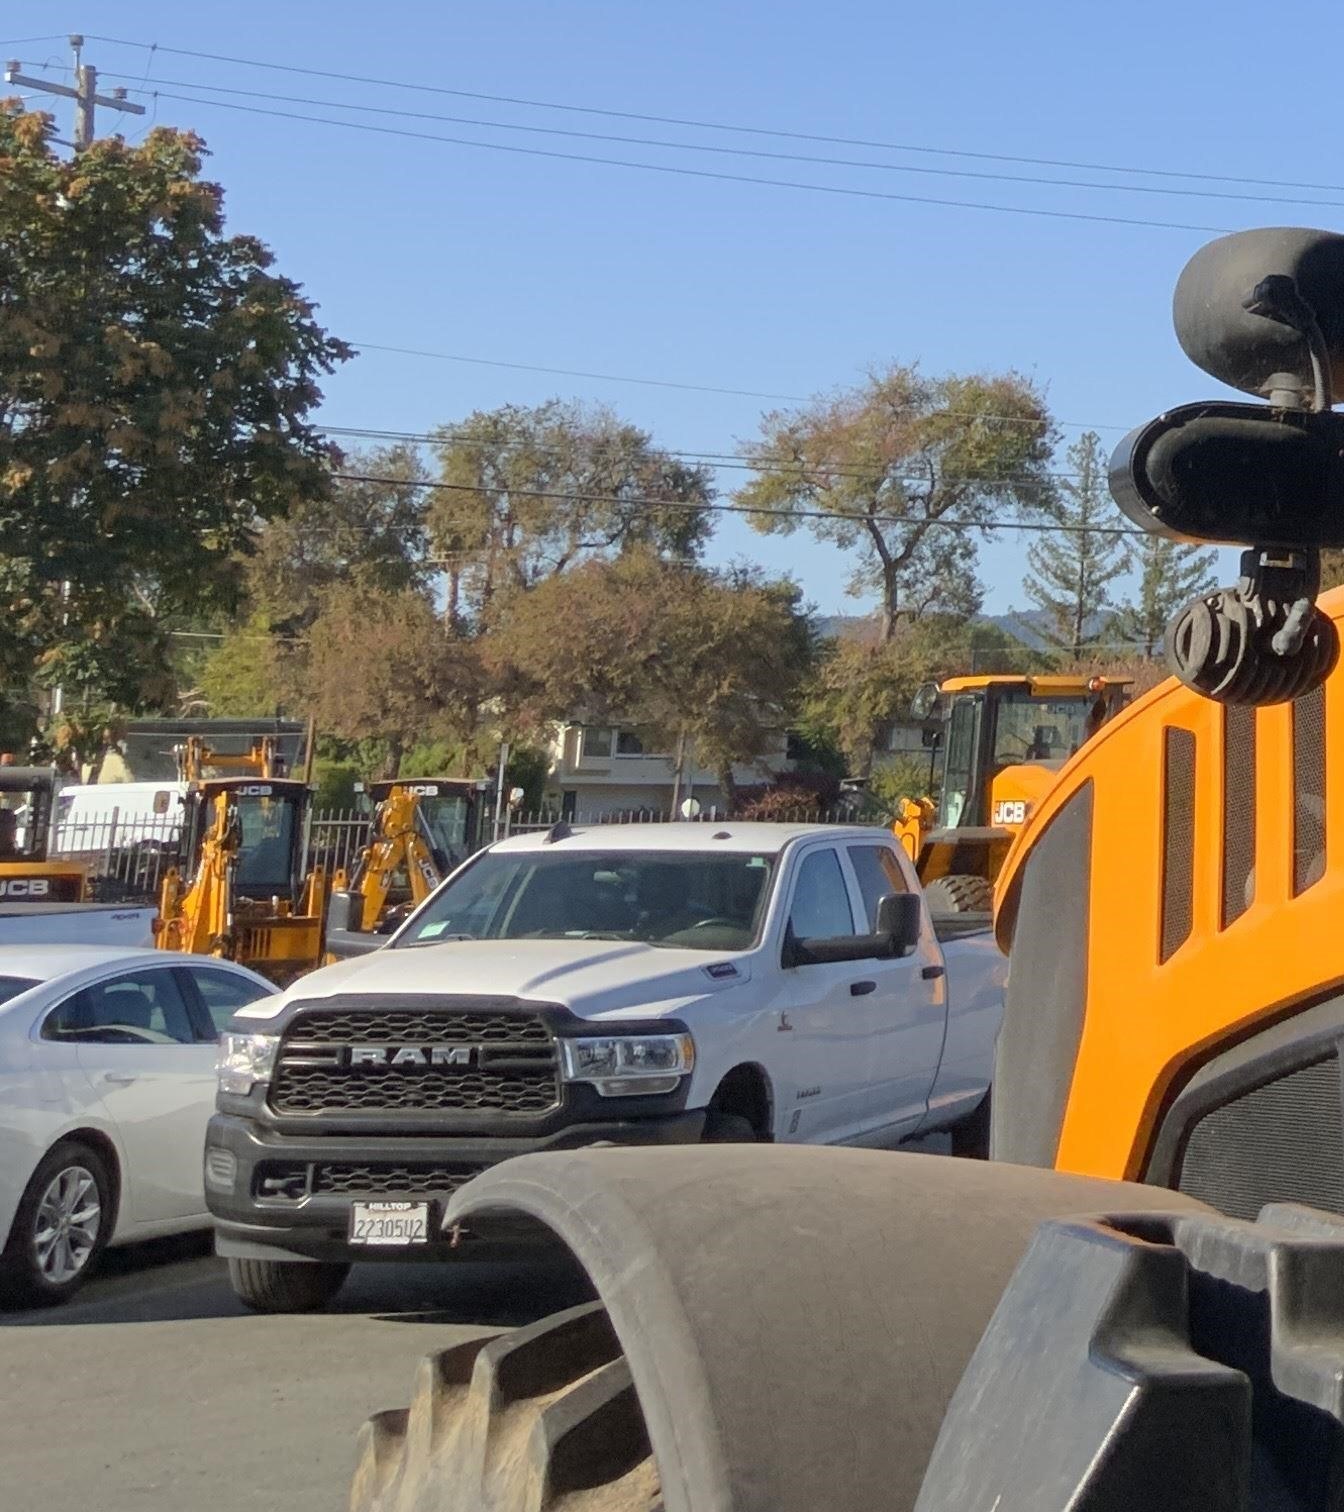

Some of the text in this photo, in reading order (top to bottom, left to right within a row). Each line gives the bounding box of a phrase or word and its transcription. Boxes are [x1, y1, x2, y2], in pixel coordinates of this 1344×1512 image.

[237, 785, 272, 796] JCB
[994, 800, 1025, 824] JCB
[351, 1047, 470, 1065] RAM
[368, 1202, 412, 1211] HILLTOP
